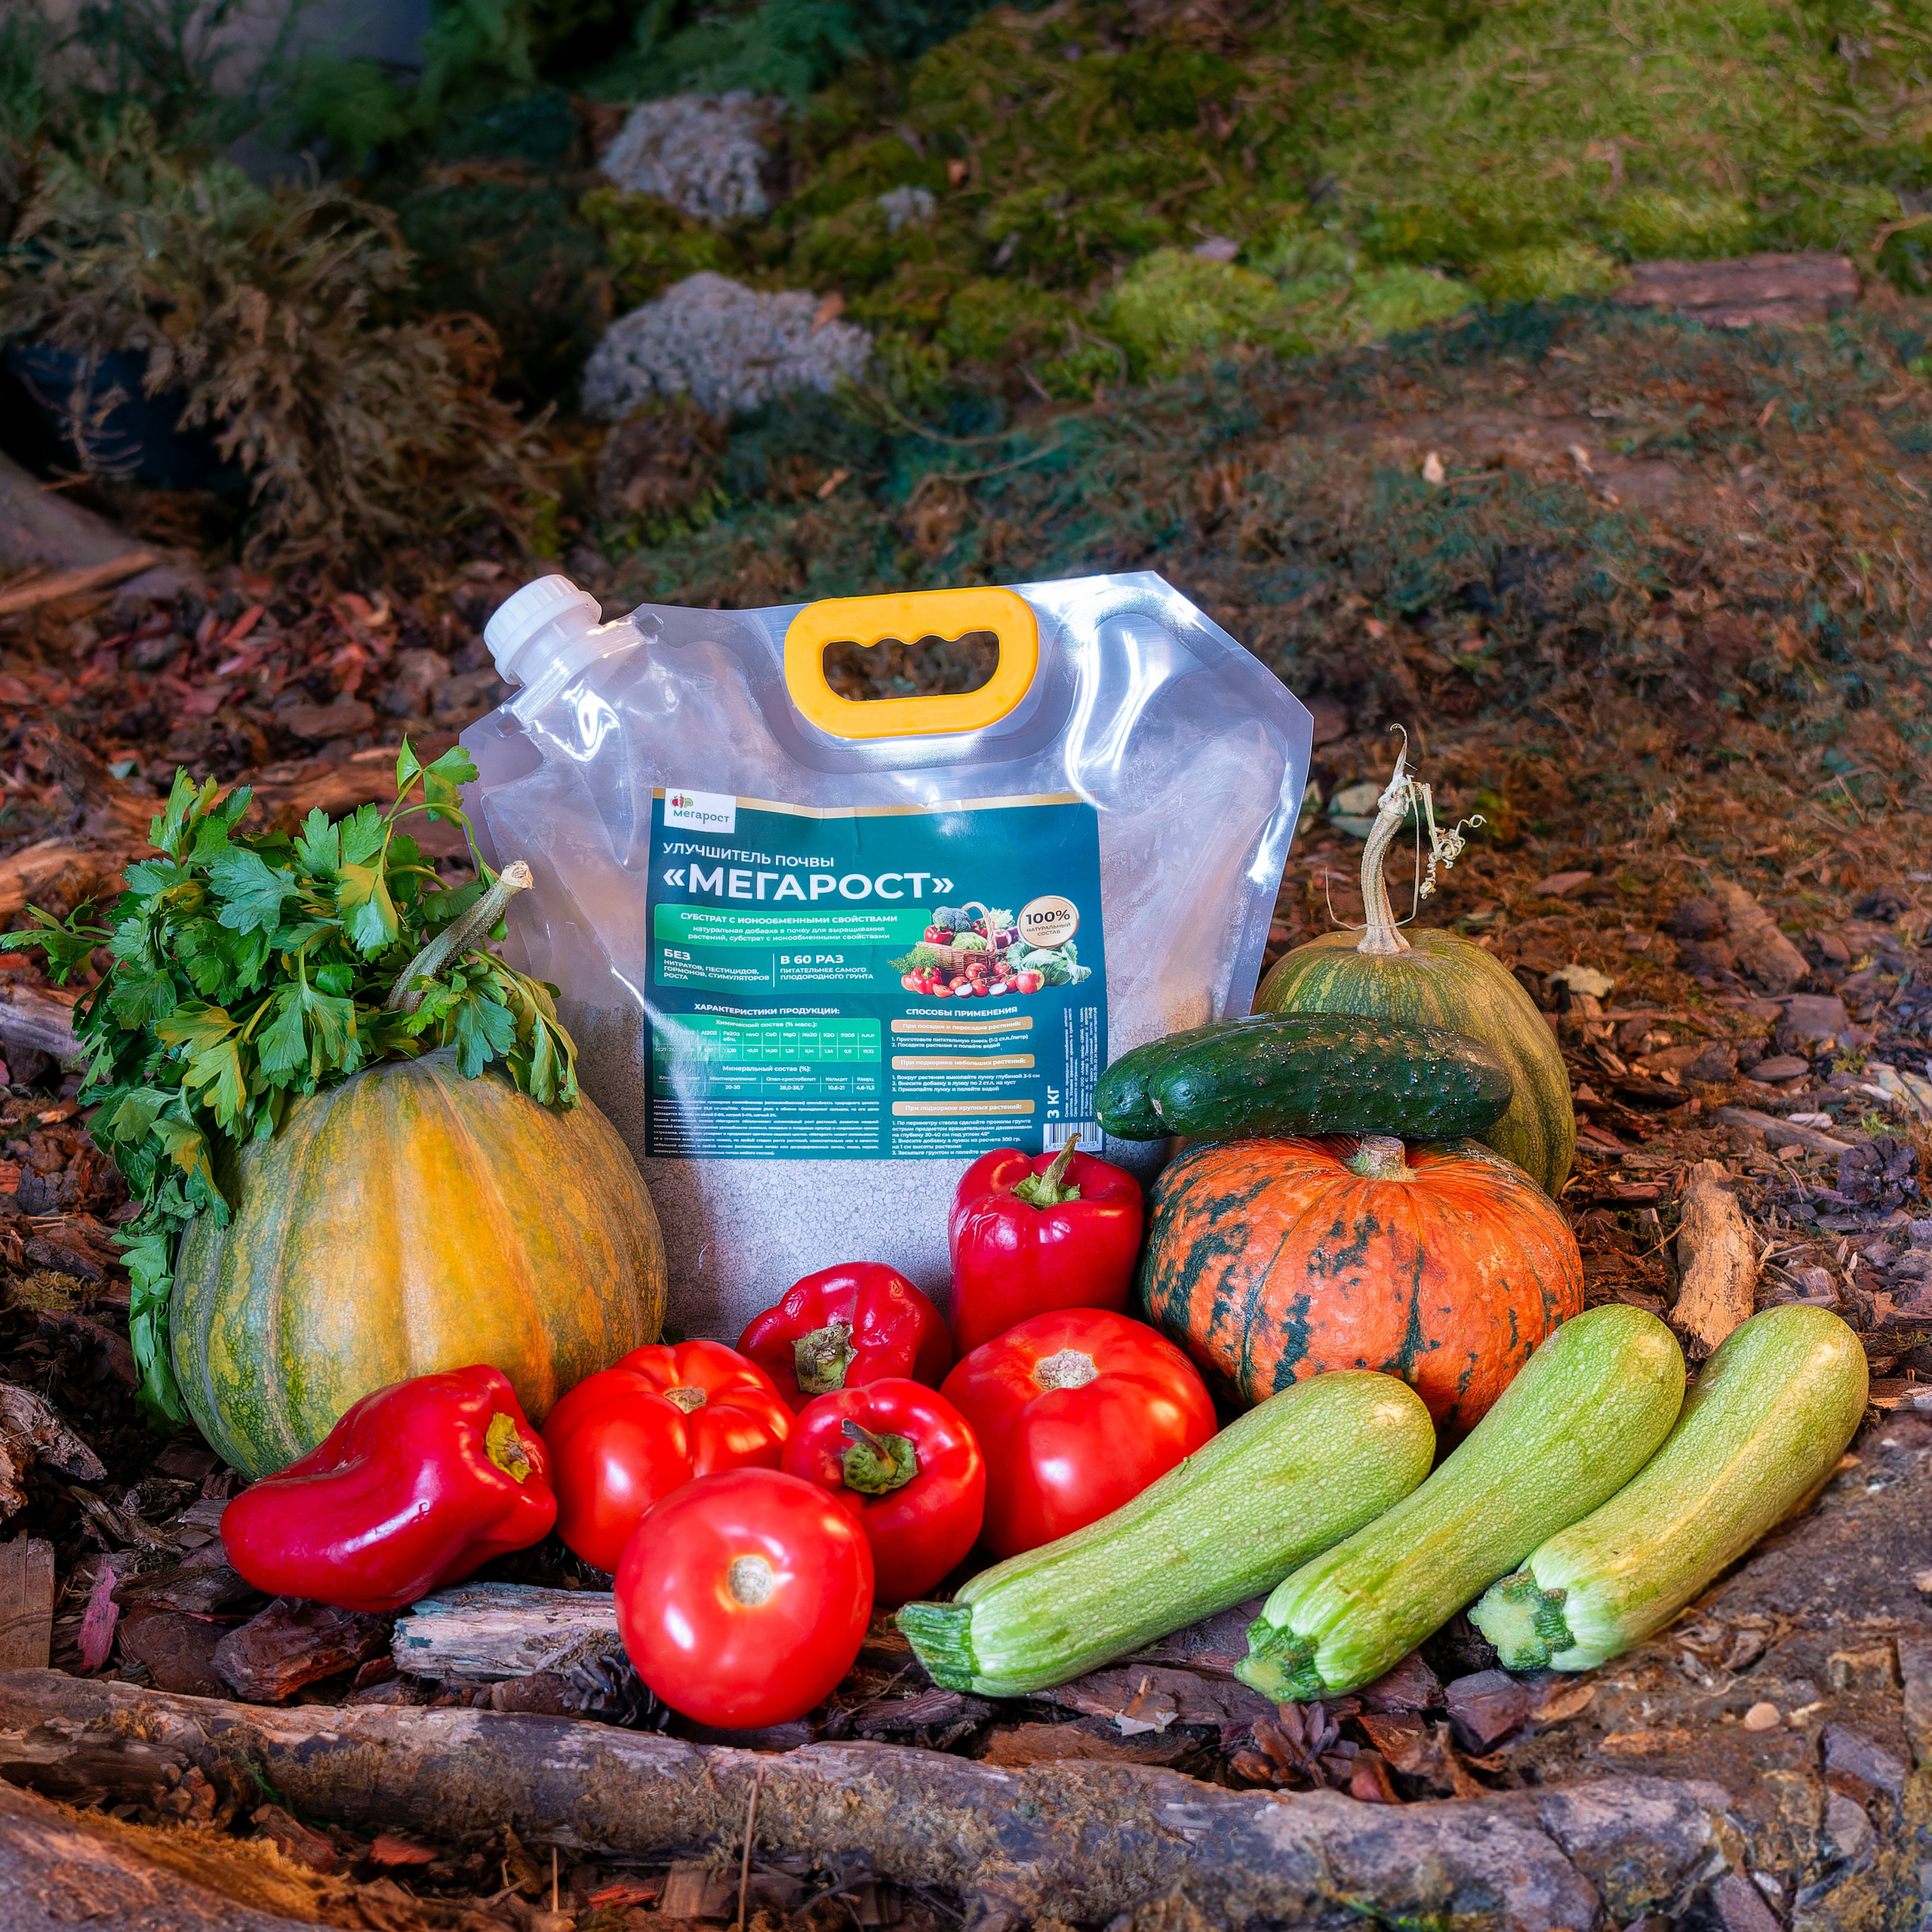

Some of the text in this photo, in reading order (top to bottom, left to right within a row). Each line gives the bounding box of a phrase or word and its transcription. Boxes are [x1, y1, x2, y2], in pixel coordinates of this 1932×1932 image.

[673, 809, 730, 824] мегарост
[663, 842, 834, 867] УЛУЧШИТЕЛЬ ПОЧВЫ
[663, 863, 954, 900] «МЕГАРОСТ»
[681, 912, 727, 923] СУБСТРАТ
[832, 915, 897, 924] СВОЙСТВАМИ
[1026, 909, 1070, 924] 100%
[1026, 922, 1071, 933] НАТУРАЛЬНЫЙ
[688, 934, 728, 942] растений,
[663, 948, 691, 961] БЕЗ
[780, 955, 844, 964] В 60 РАЗ
[663, 959, 759, 975] НИТРАТОВ, ПЕСТИЦИДОВ,
[663, 965, 770, 981] ГОРМОНОВ, СТИМУЛЯТОРОВ
[663, 972, 688, 980] РОСТА
[694, 1003, 777, 1015] ХАРАКТЕРИСТИКИ
[955, 1006, 1017, 1017] ПРИМЕНЕНИЯ
[989, 1021, 1021, 1031] растений:
[1048, 1085, 1060, 1118] 3 КГ
